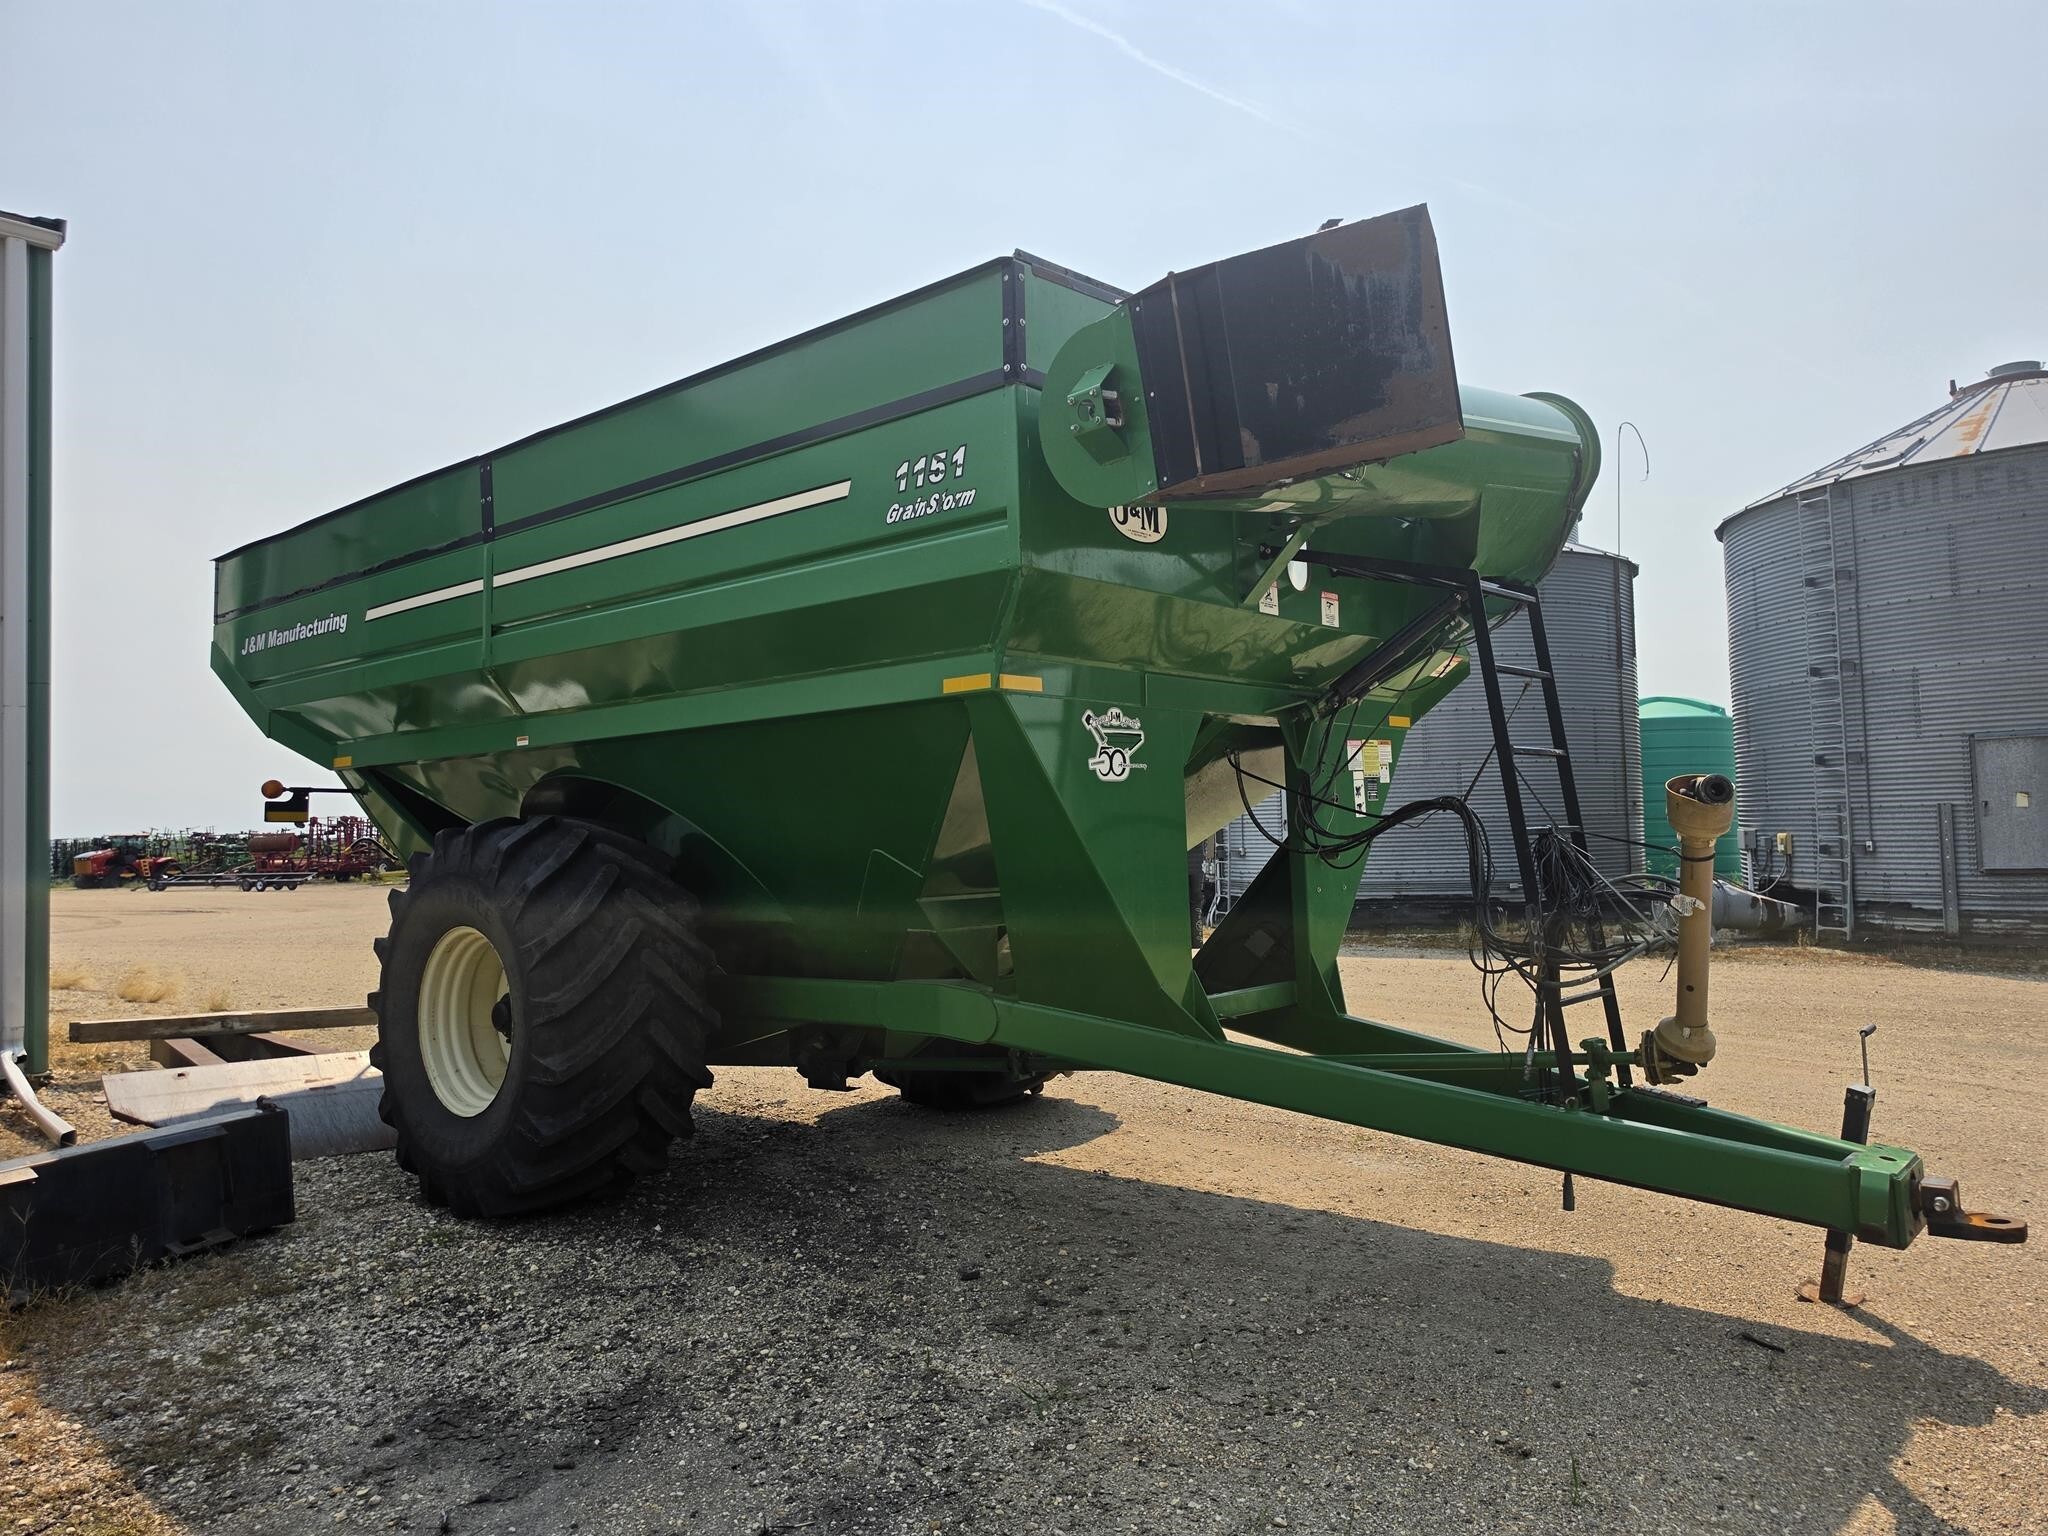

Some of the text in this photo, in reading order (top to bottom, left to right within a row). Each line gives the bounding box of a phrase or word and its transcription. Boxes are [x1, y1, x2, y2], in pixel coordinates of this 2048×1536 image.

[895, 443, 967, 493] 1151
[241, 612, 348, 656] J&M Manufacturing
[1099, 746, 1127, 777] 50
